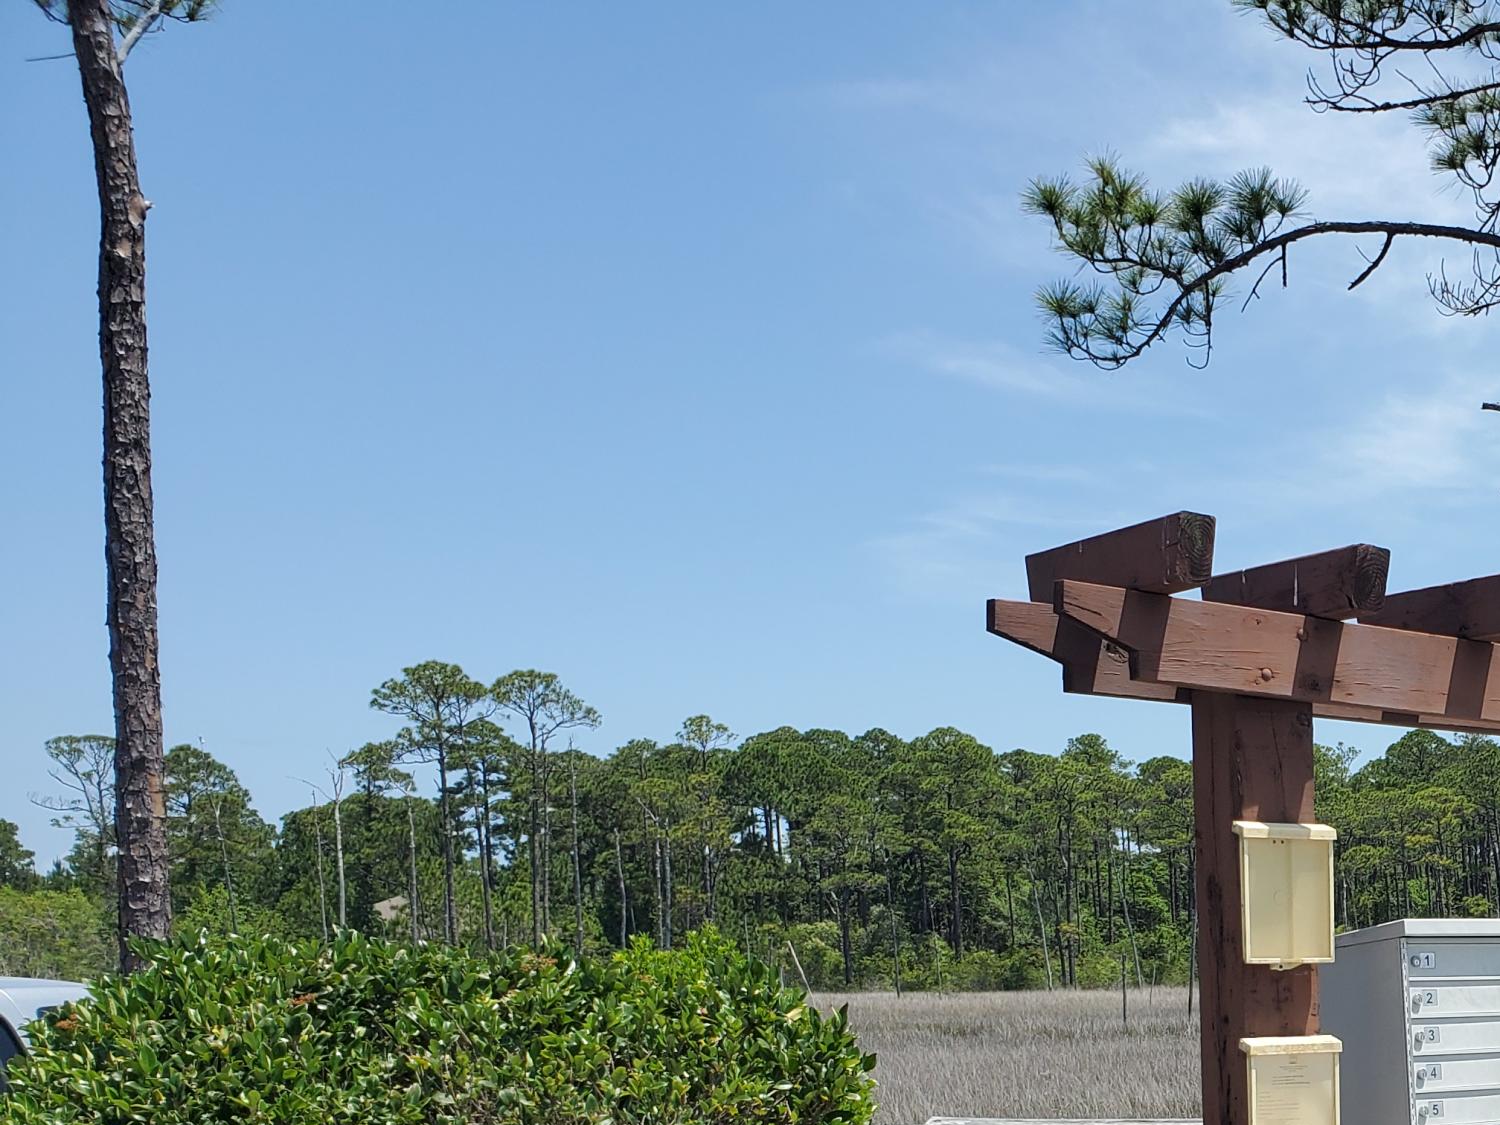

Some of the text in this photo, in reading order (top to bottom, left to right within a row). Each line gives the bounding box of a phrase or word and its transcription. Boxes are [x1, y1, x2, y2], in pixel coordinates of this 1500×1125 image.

[1424, 954, 1430, 966] 1
[1426, 993, 1433, 1004] 2
[1428, 1030, 1435, 1041] 3
[1430, 1067, 1437, 1078] 4
[1432, 1104, 1439, 1116] 5
